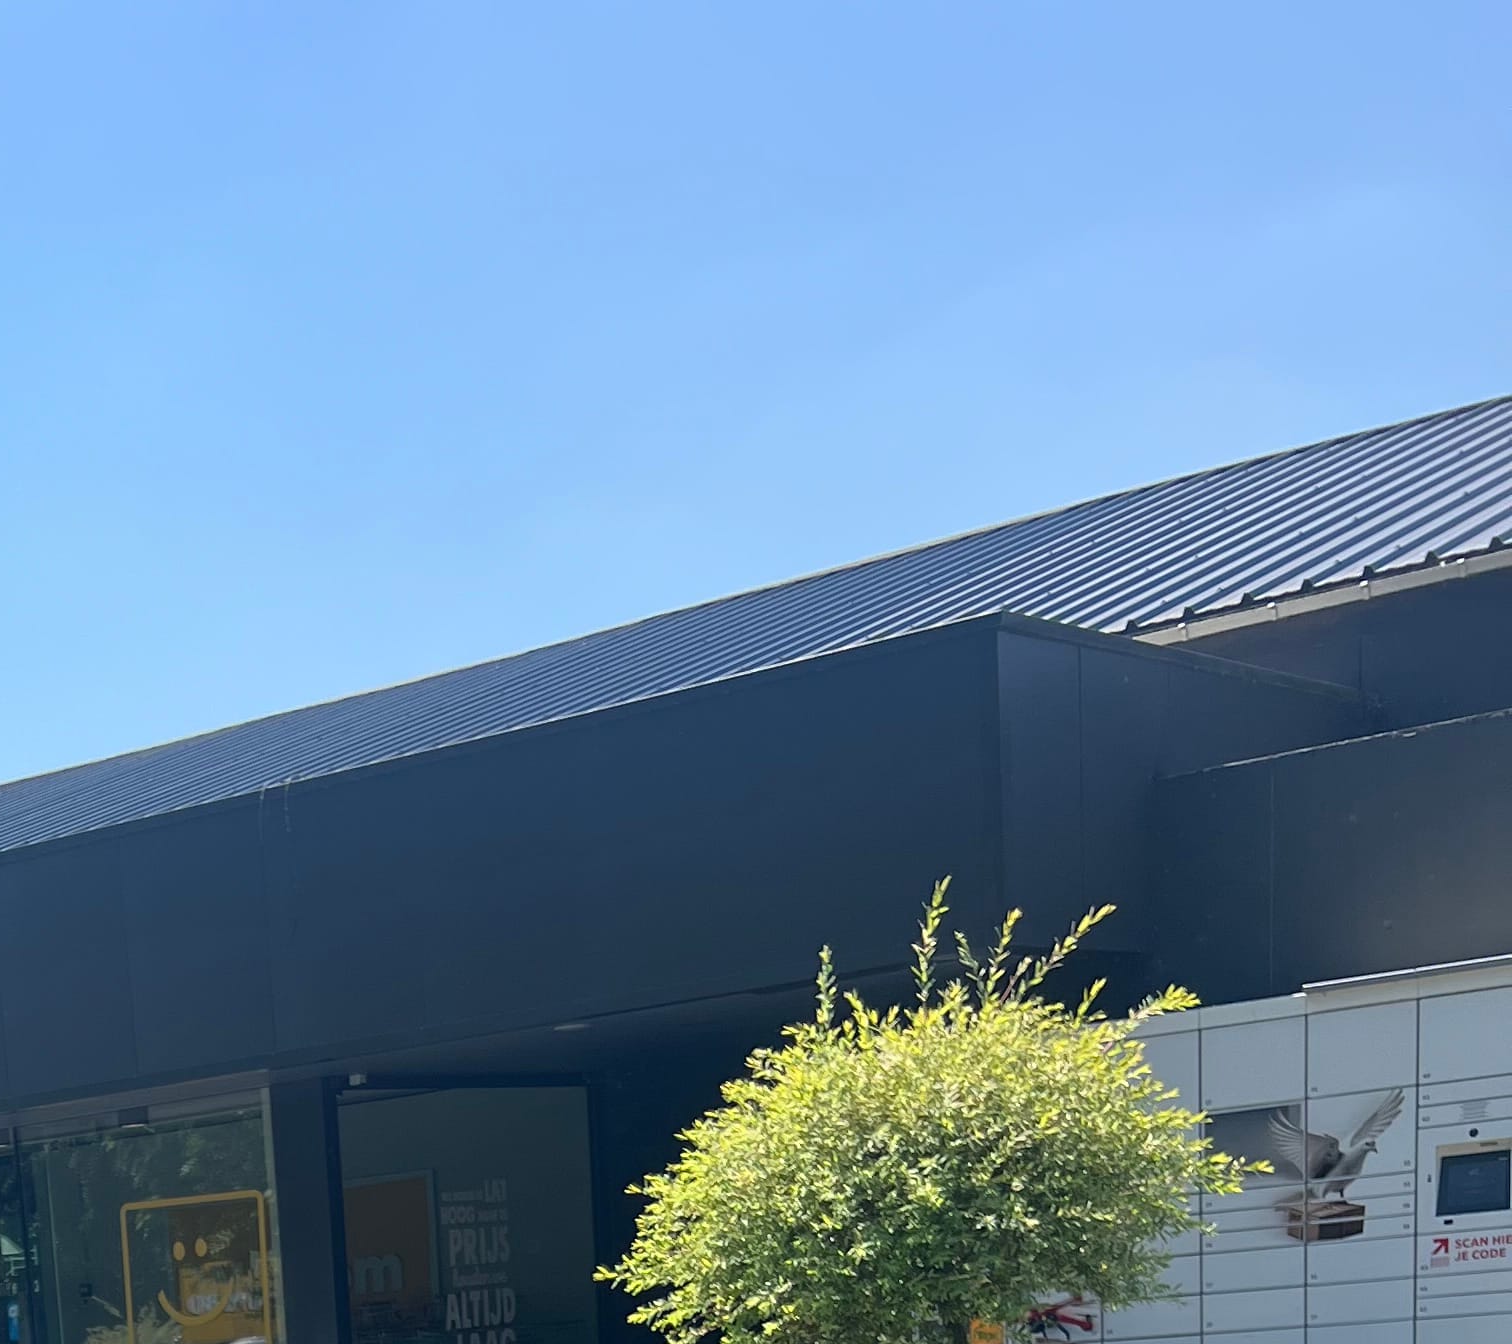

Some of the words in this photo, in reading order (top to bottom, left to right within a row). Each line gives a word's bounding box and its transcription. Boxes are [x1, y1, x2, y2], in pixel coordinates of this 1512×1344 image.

[448, 1226, 511, 1267] PRIJS
[1454, 1237, 1489, 1249] SCAN
[1454, 1251, 1469, 1262] JE
[1471, 1247, 1507, 1260] CODE
[445, 1287, 517, 1331] ALTIJD
